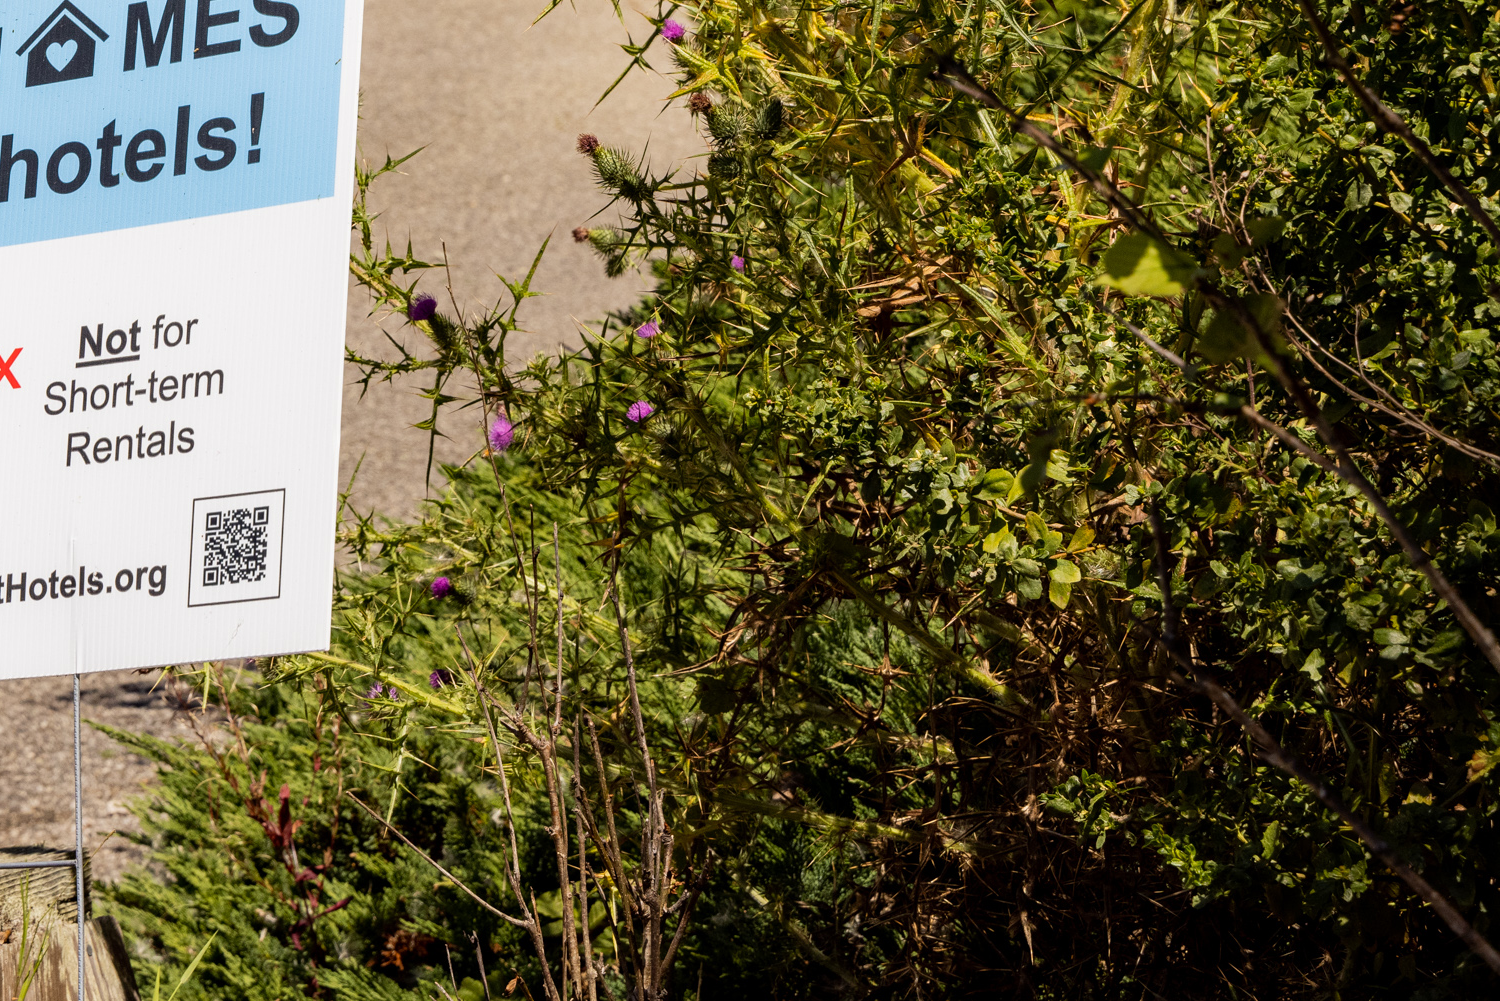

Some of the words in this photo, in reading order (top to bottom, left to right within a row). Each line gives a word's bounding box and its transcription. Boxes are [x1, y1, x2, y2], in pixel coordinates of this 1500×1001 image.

[78, 319, 141, 360] Not
[152, 314, 199, 349] for
[44, 364, 225, 416] Short-term
[66, 421, 195, 467] Rentals
